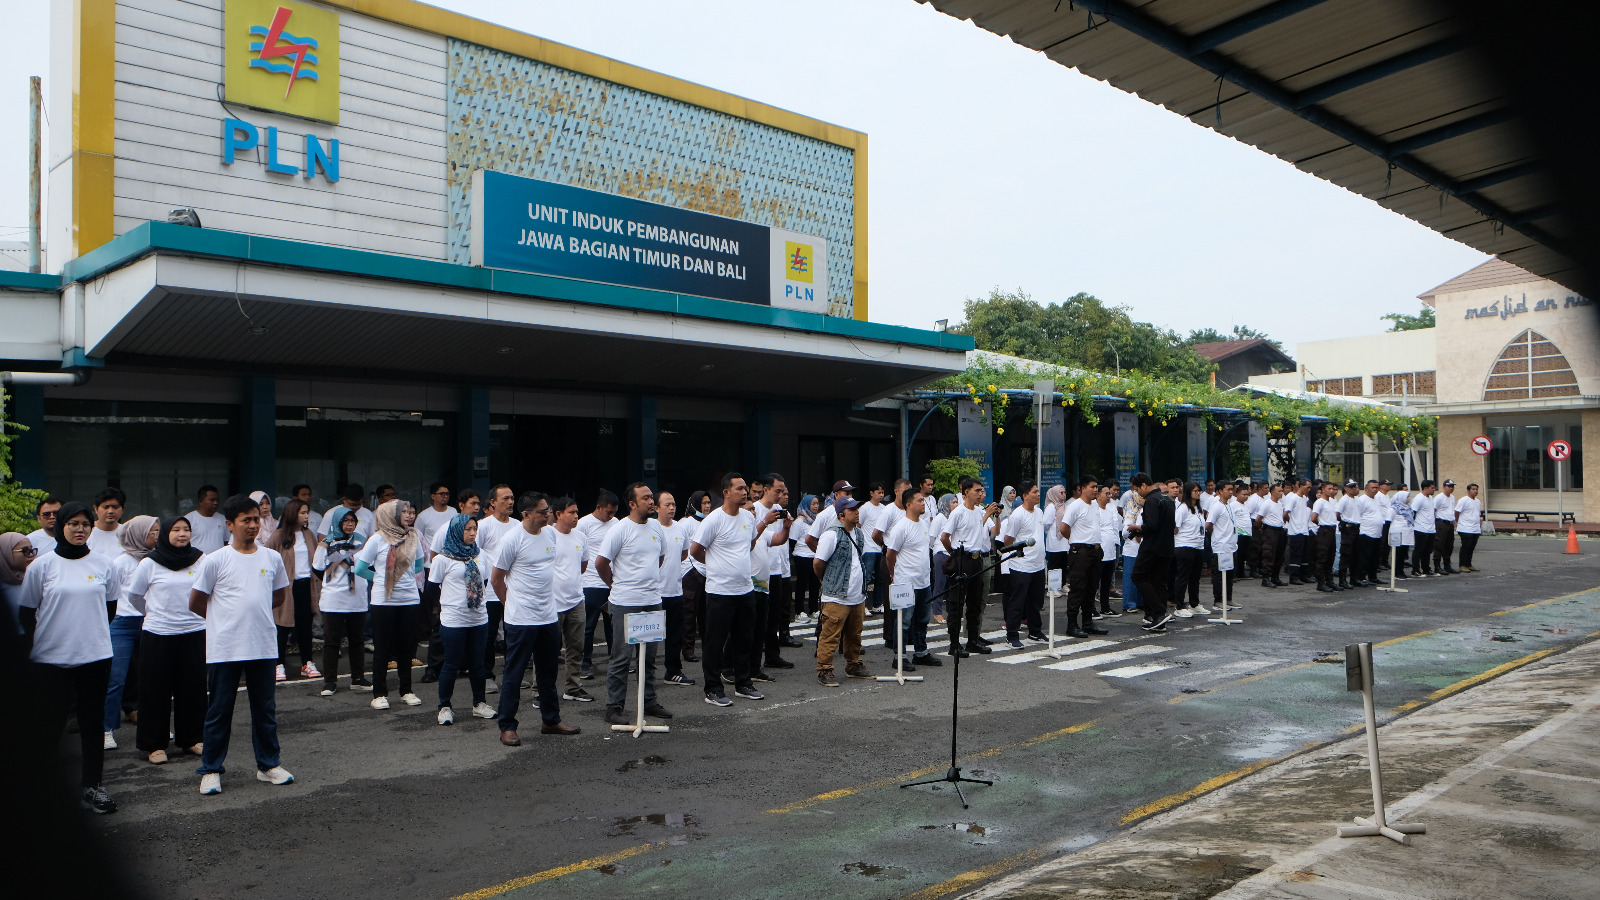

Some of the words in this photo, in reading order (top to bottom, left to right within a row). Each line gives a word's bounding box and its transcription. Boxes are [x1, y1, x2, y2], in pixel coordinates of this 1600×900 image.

[221, 117, 339, 183] PLN
[517, 229, 565, 252] JAWA
[569, 234, 630, 262] BAGIAN
[633, 247, 681, 271] TIMUR
[683, 256, 714, 275] DAN
[717, 262, 746, 281] BALI
[528, 202, 568, 225] UNIT
[572, 209, 624, 235] INDUK
[627, 220, 740, 256] PEMBANGUNAN
[785, 284, 814, 302] PLN
